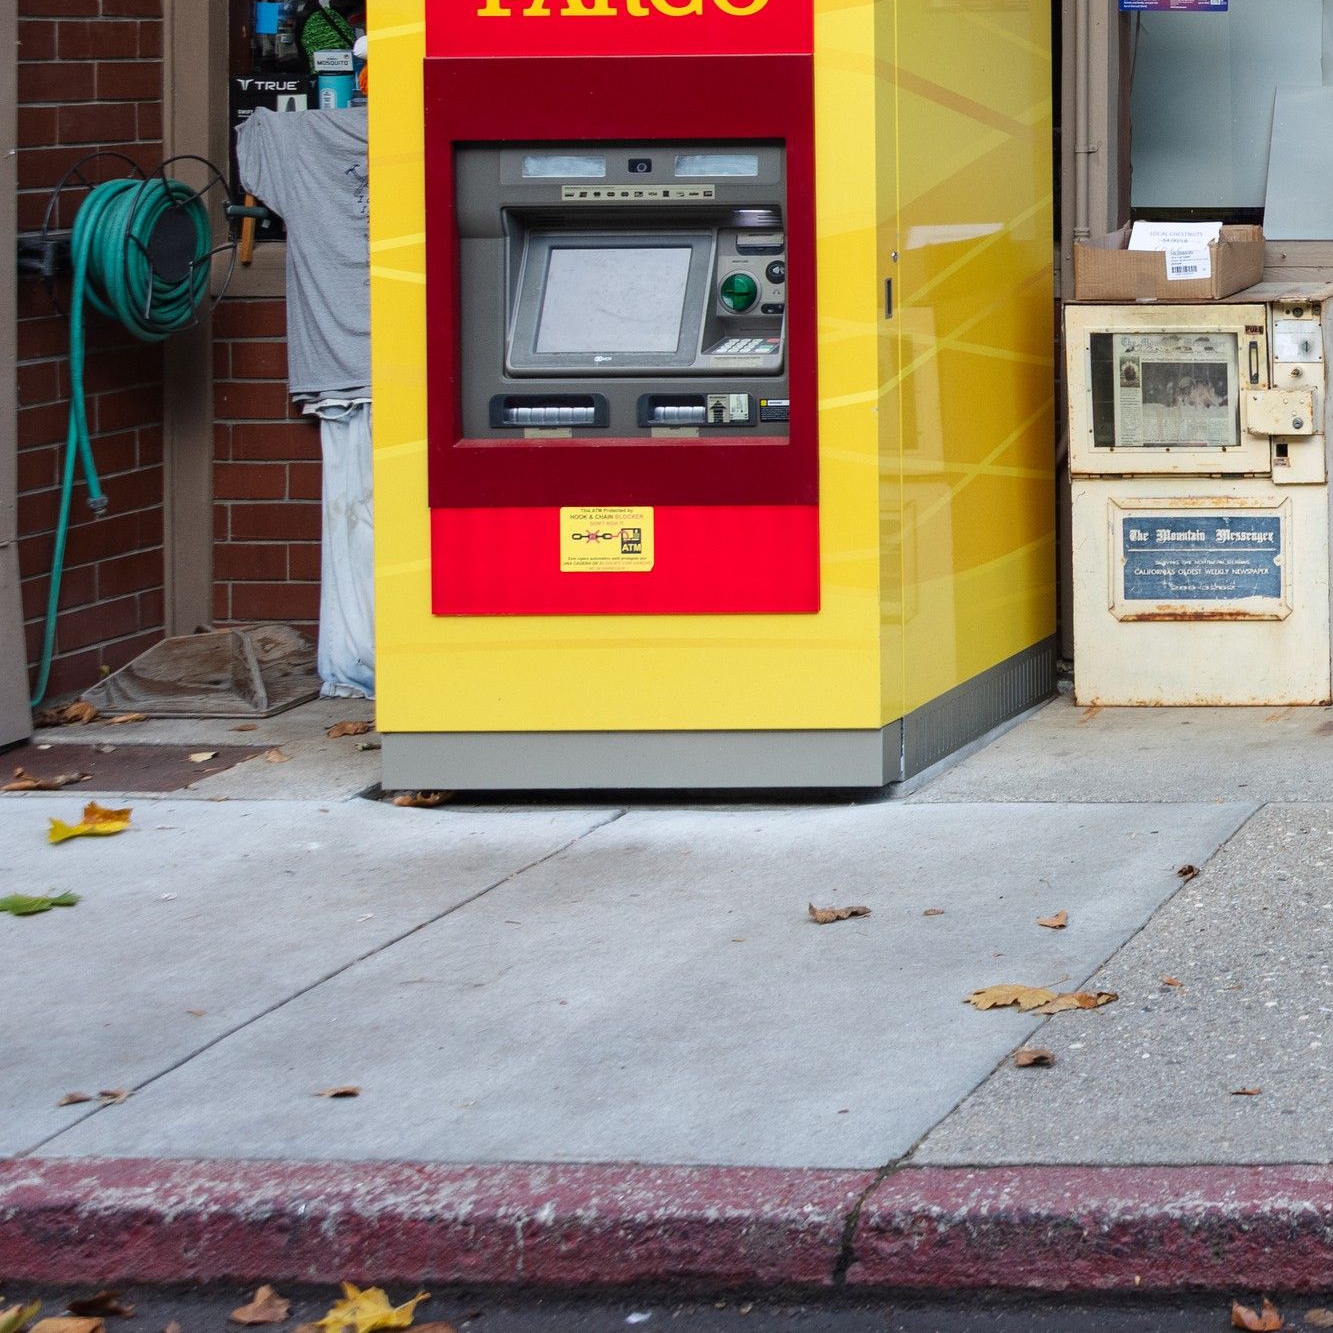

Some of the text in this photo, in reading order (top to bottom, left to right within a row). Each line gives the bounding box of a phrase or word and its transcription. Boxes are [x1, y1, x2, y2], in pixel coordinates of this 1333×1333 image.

[254, 81, 297, 90] TRUE
[1129, 529, 1274, 544] The Mountain Messenger
